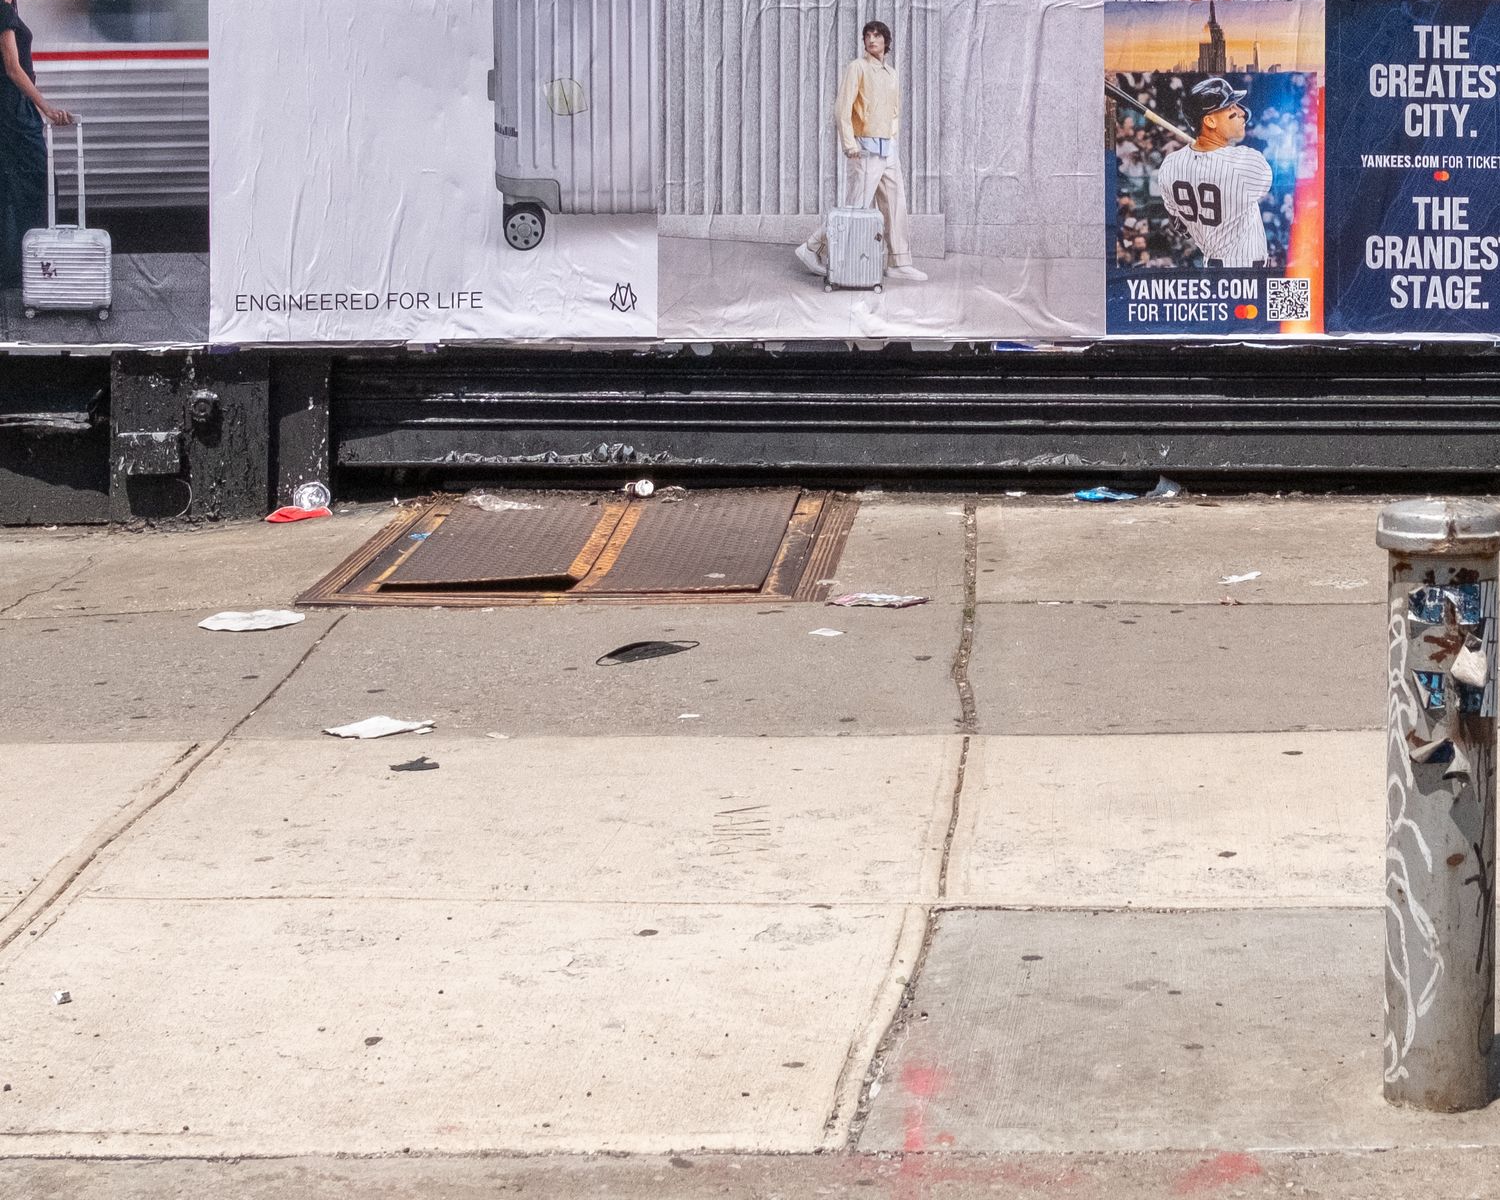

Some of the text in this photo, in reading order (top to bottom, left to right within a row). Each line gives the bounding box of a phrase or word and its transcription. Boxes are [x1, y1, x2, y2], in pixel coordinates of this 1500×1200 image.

[1413, 25, 1470, 59] THE
[1404, 103, 1478, 138] CITY.
[1361, 155, 1439, 168] YANKEES.COM
[1442, 155, 1463, 168] FOR
[1172, 180, 1222, 227] 99
[1412, 196, 1470, 231] THE
[235, 291, 483, 312] ENGINEERED FOR LIFE
[1127, 278, 1258, 300] YANKEES.COM
[1390, 275, 1490, 310] STAGE.
[1128, 303, 1229, 322] FOR TICKETS
